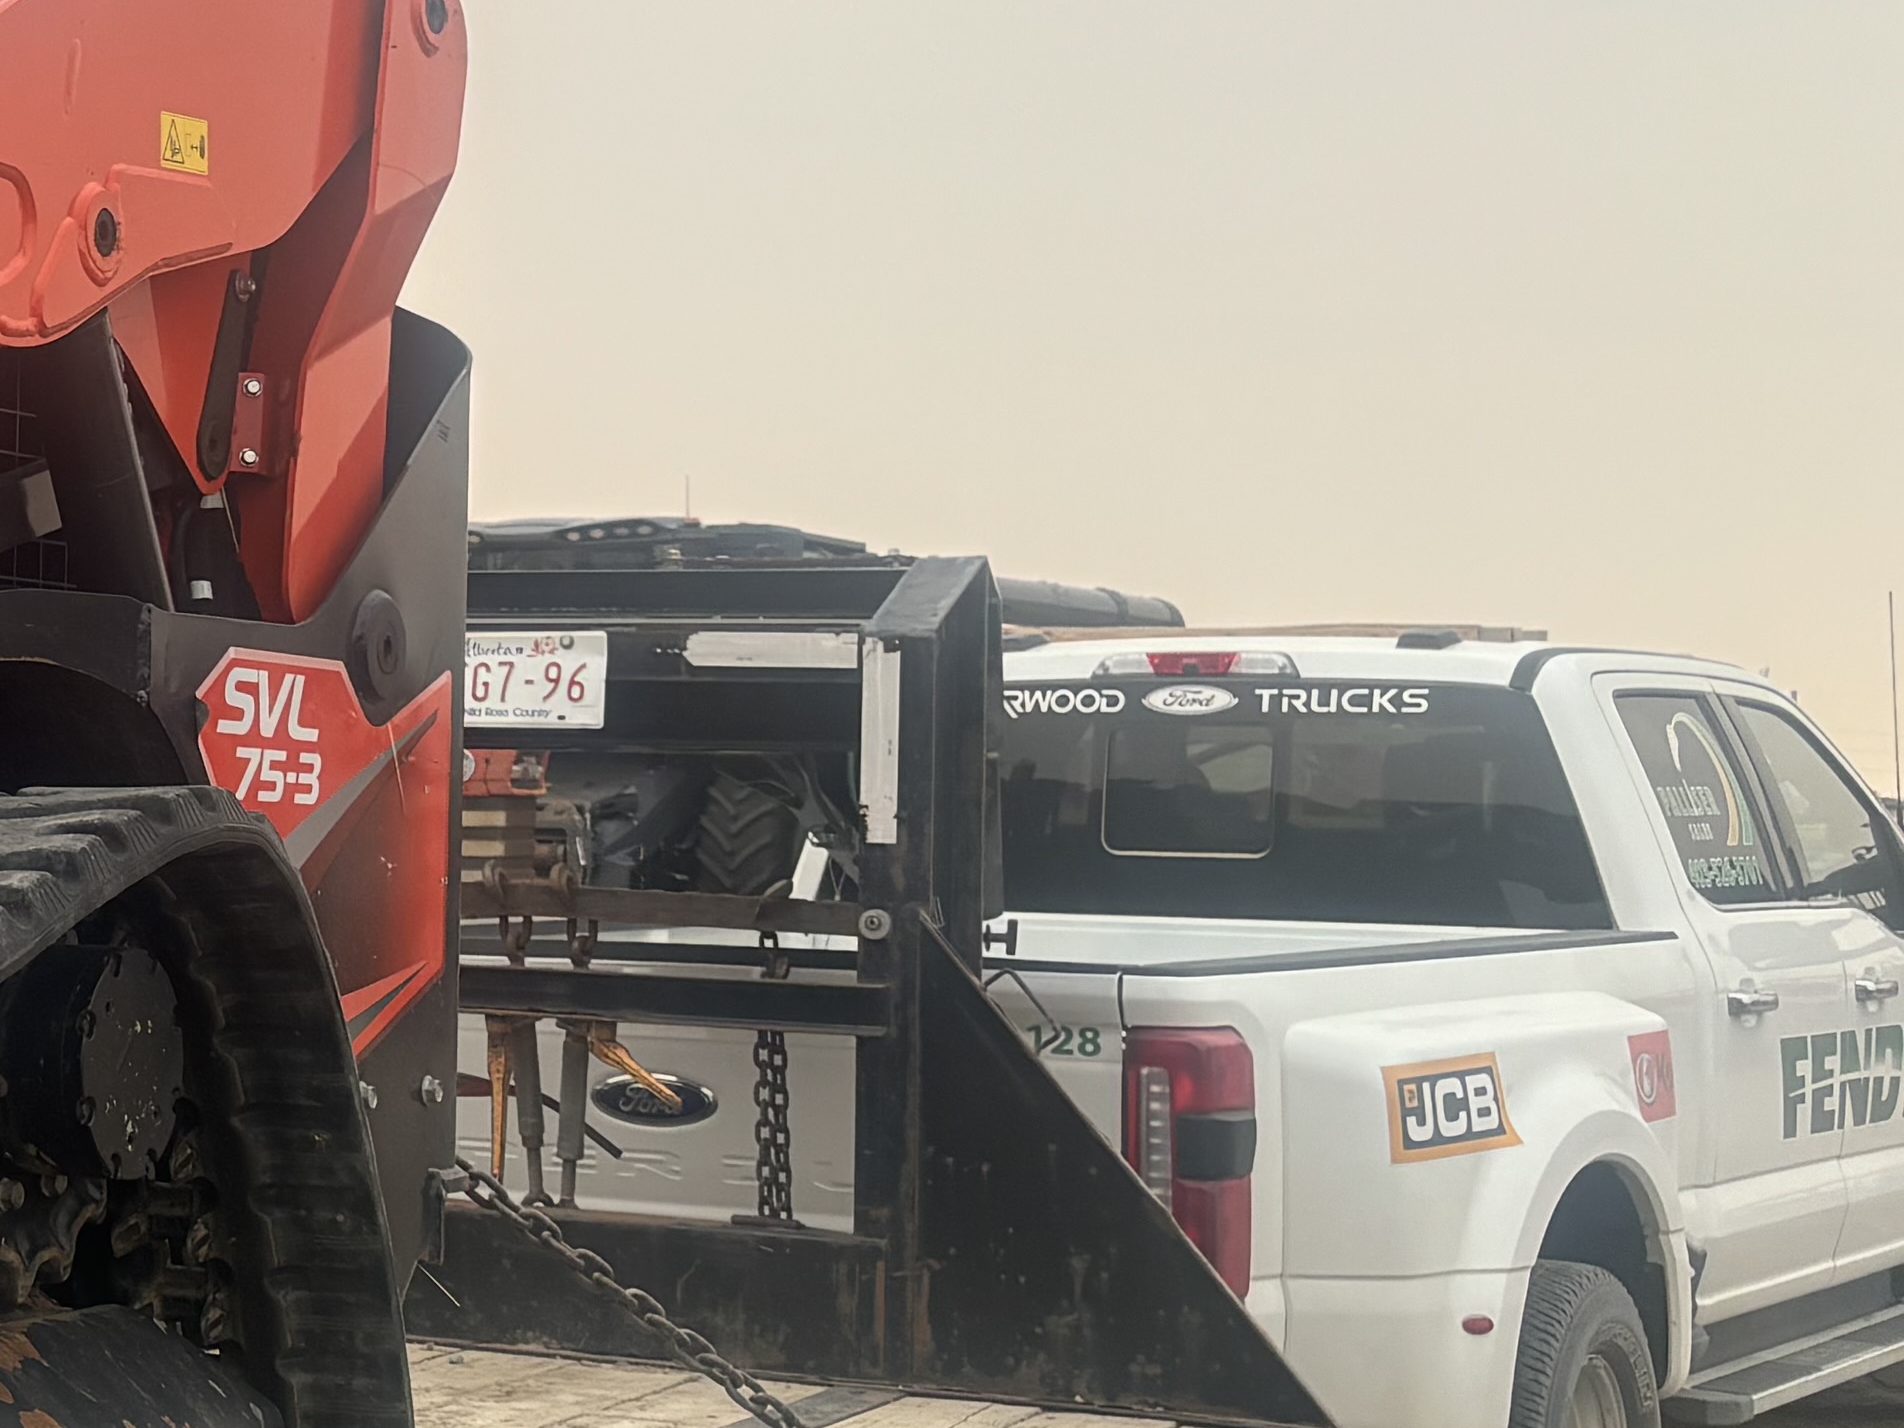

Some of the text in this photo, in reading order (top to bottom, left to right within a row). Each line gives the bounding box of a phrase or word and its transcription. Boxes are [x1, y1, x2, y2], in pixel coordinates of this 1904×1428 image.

[216, 666, 320, 742] SVL
[465, 661, 588, 703] G7-96
[1003, 687, 1431, 719] RWOOD Ford TRUCKS
[235, 746, 322, 805] 75-3
[1025, 1024, 1102, 1057] 128
[1404, 1072, 1500, 1142] JCB
[1779, 1023, 1904, 1140] FEND
